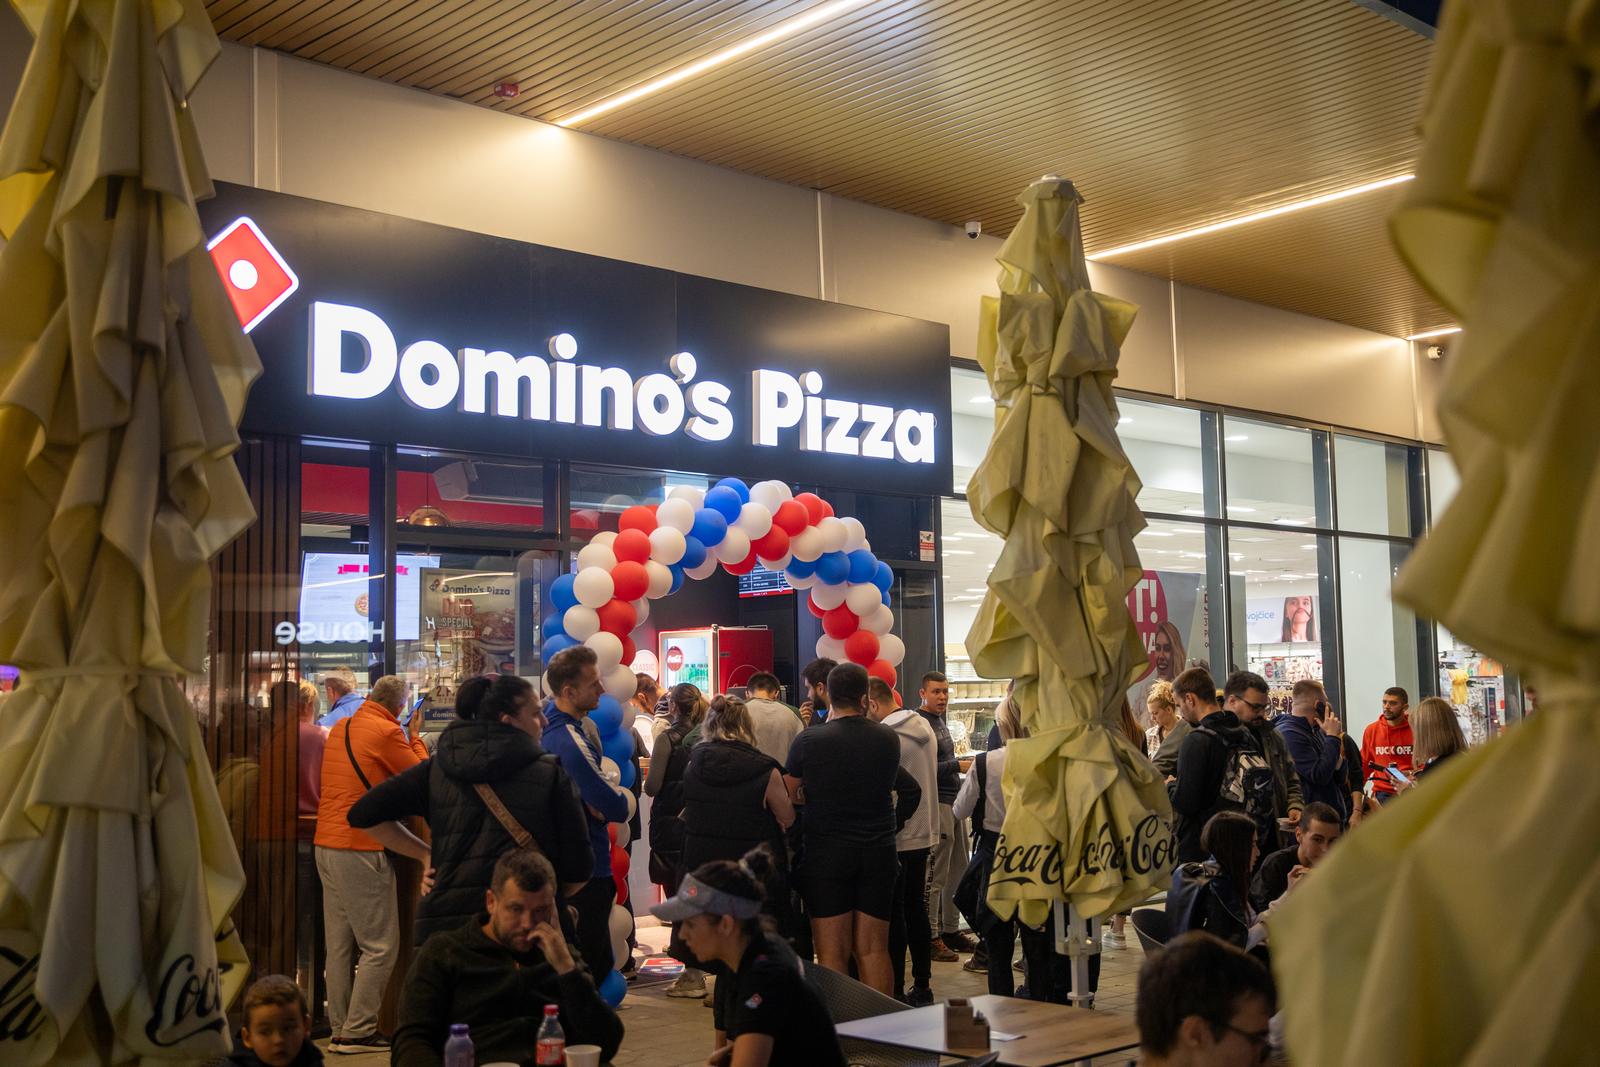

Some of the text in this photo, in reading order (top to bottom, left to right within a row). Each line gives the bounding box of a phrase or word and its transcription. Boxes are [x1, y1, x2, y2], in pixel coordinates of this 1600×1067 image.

[308, 300, 937, 464] Domino's Pizza
[442, 584, 511, 596] Domino's Pizza
[1125, 579, 1158, 624] T!
[1375, 745, 1396, 755] FUCK
